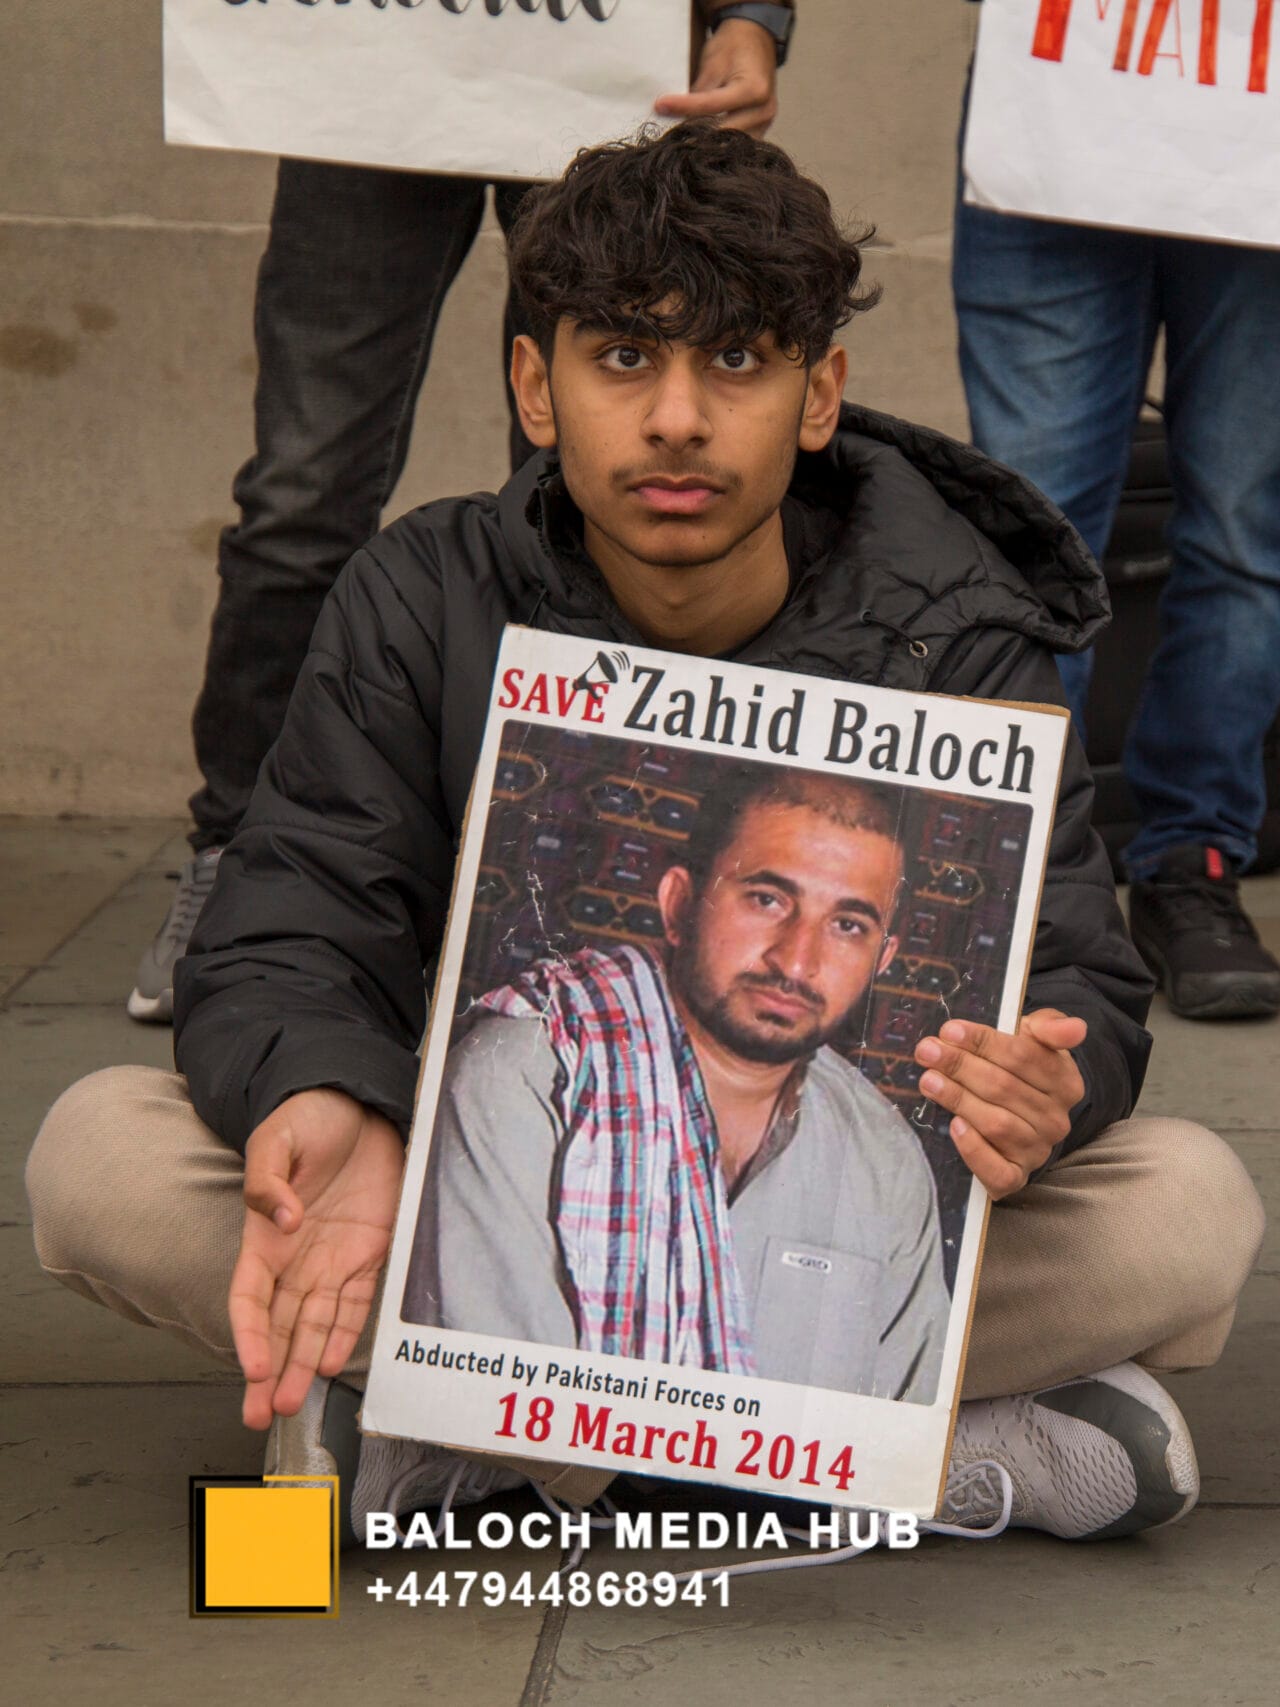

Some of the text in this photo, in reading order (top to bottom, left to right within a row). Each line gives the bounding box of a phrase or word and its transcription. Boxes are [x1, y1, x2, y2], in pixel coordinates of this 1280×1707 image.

[498, 664, 1036, 795] SAVE Zahid Baloch
[394, 1339, 760, 1417] Abducted by Pakistani Forces on
[493, 1391, 856, 1491] 18 March 2014
